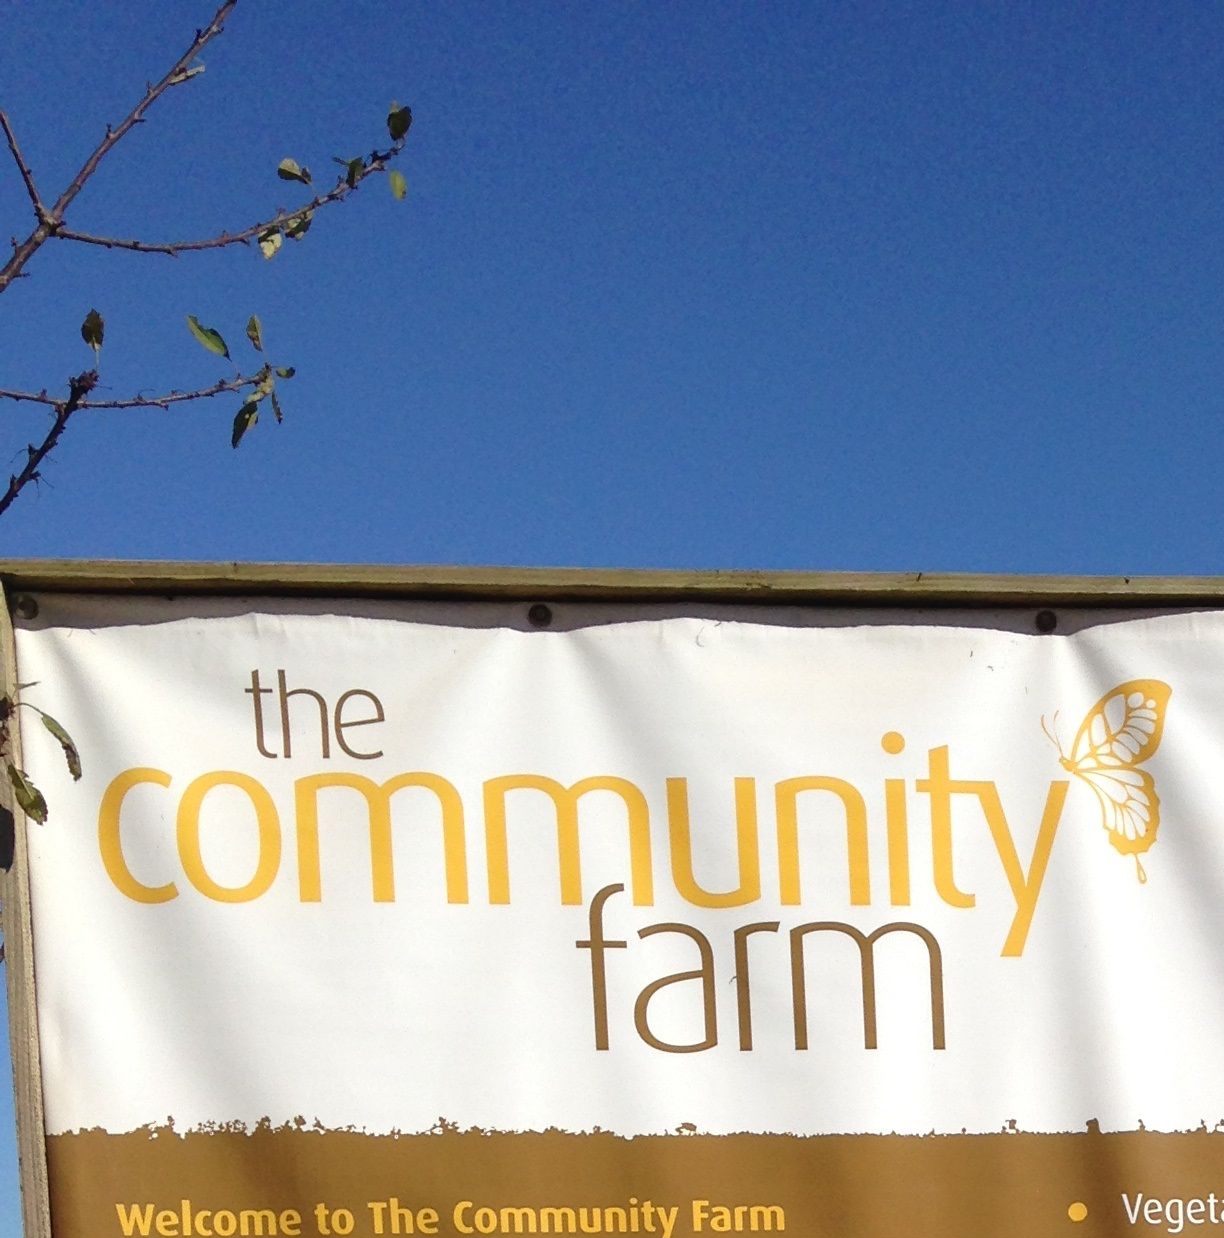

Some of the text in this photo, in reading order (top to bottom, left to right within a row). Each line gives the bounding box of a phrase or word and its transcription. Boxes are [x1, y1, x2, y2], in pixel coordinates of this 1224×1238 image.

[244, 668, 386, 760] the
[97, 730, 1070, 958] community
[574, 882, 947, 1054] farm
[115, 1199, 301, 1237] Welcome
[314, 1202, 355, 1236] to
[367, 1197, 439, 1235] The
[692, 1199, 786, 1233] Farm
